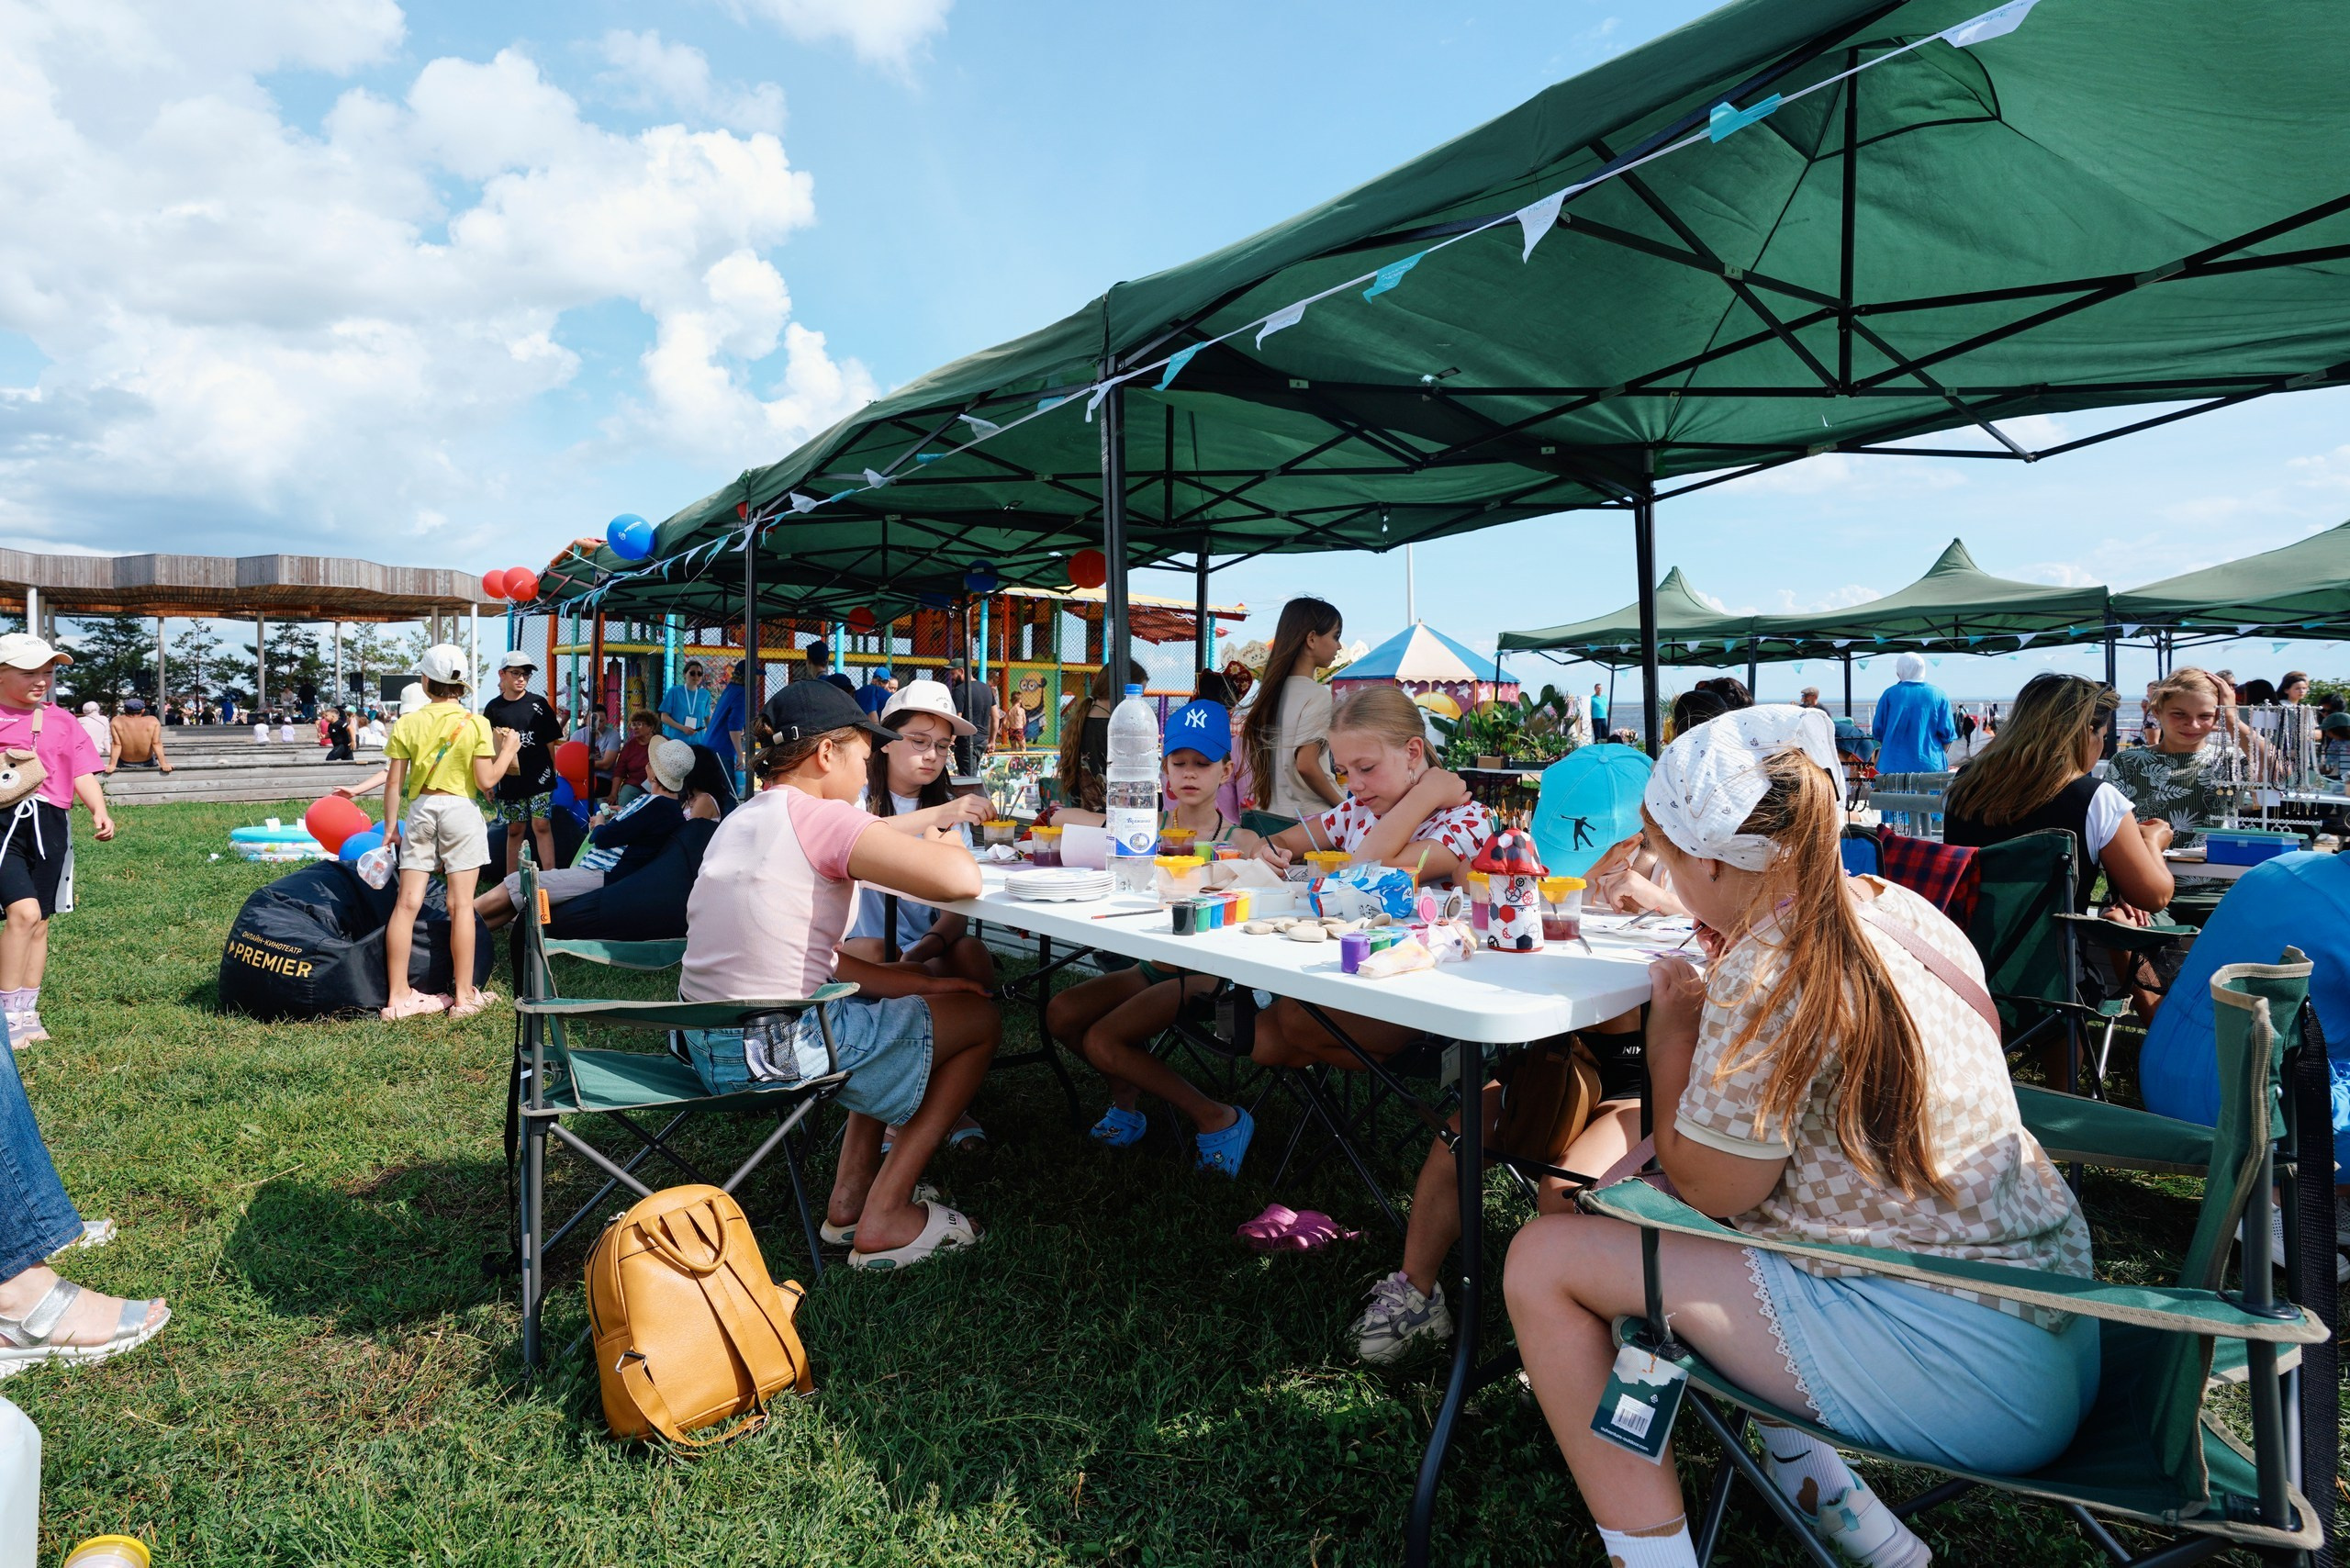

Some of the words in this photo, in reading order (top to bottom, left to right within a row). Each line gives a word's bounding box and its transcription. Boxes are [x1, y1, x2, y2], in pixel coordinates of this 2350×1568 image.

[1184, 708, 1208, 728] NY
[241, 930, 303, 955] ОНЛАЙН-КИНОТЕАТР
[233, 942, 313, 979] PREMIER
[1622, 1046, 1641, 1055] NIK
[947, 1211, 957, 1226] LOV
